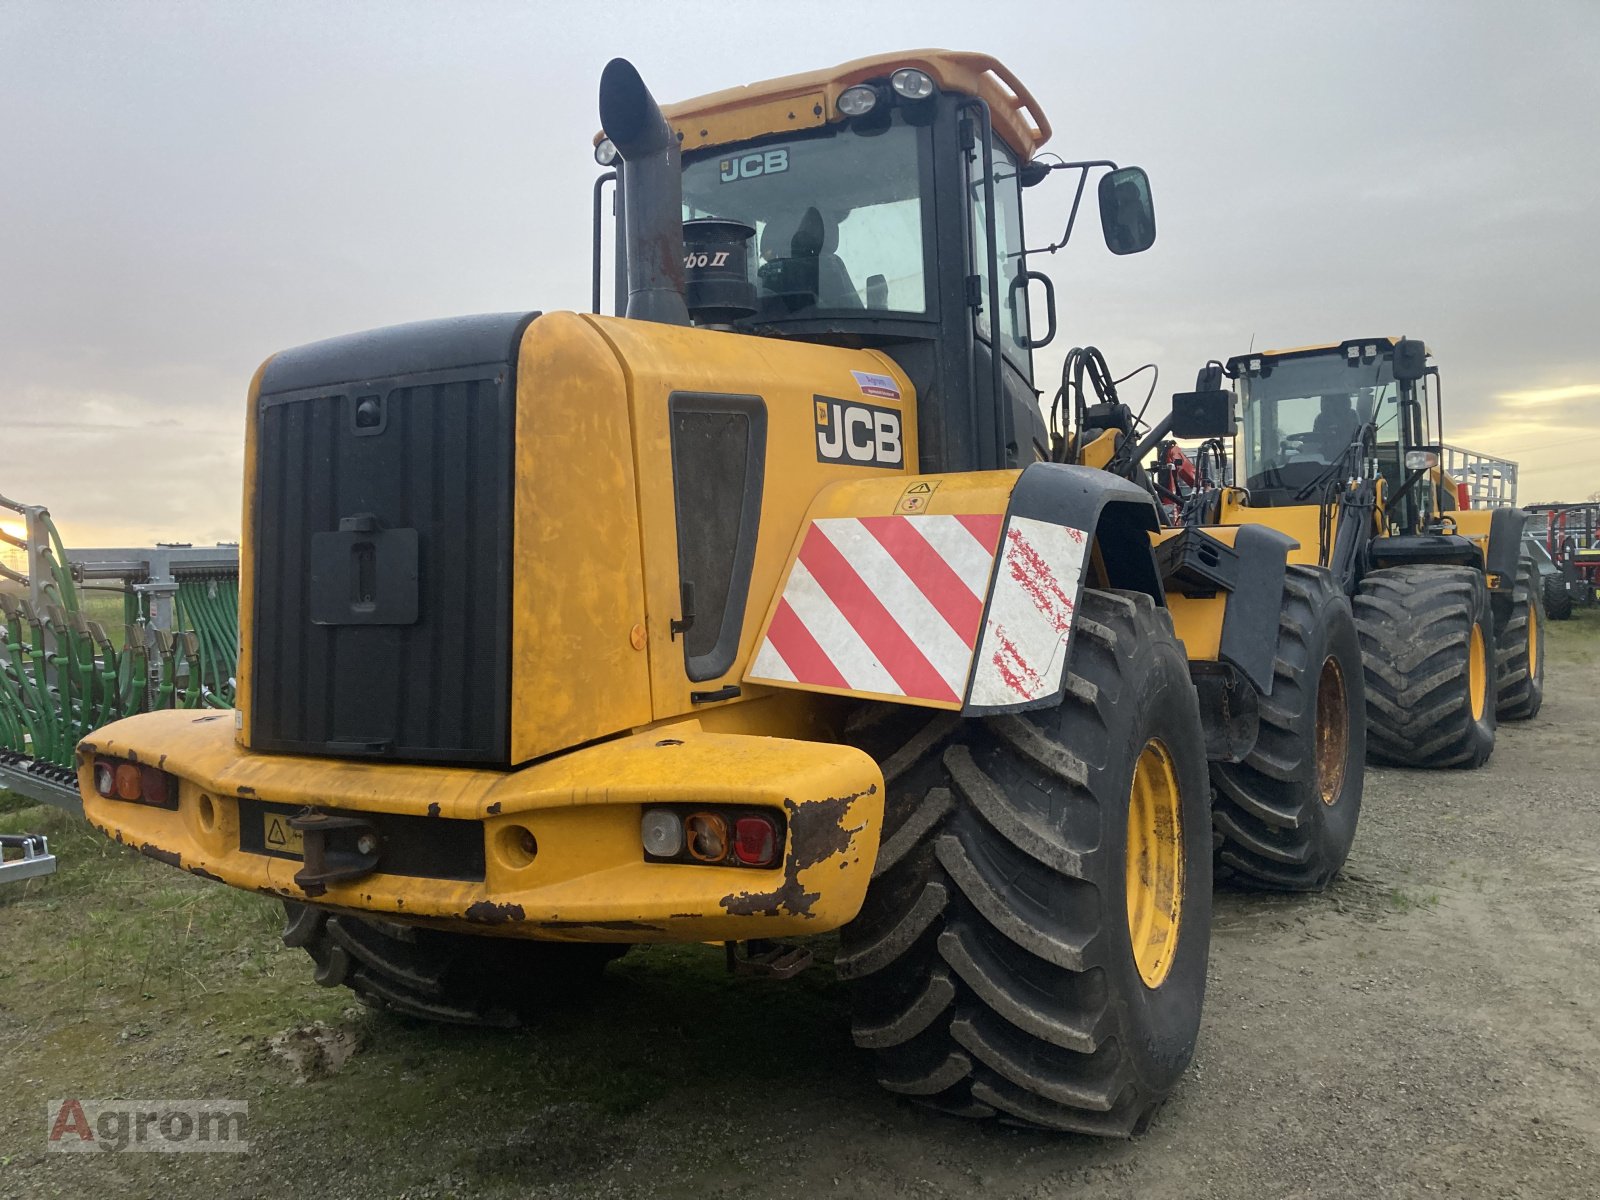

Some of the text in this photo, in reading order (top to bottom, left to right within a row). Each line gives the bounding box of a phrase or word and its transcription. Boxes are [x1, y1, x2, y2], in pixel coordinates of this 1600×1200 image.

[721, 150, 788, 182] JCB
[709, 252, 730, 267] II
[818, 404, 902, 464] JCB
